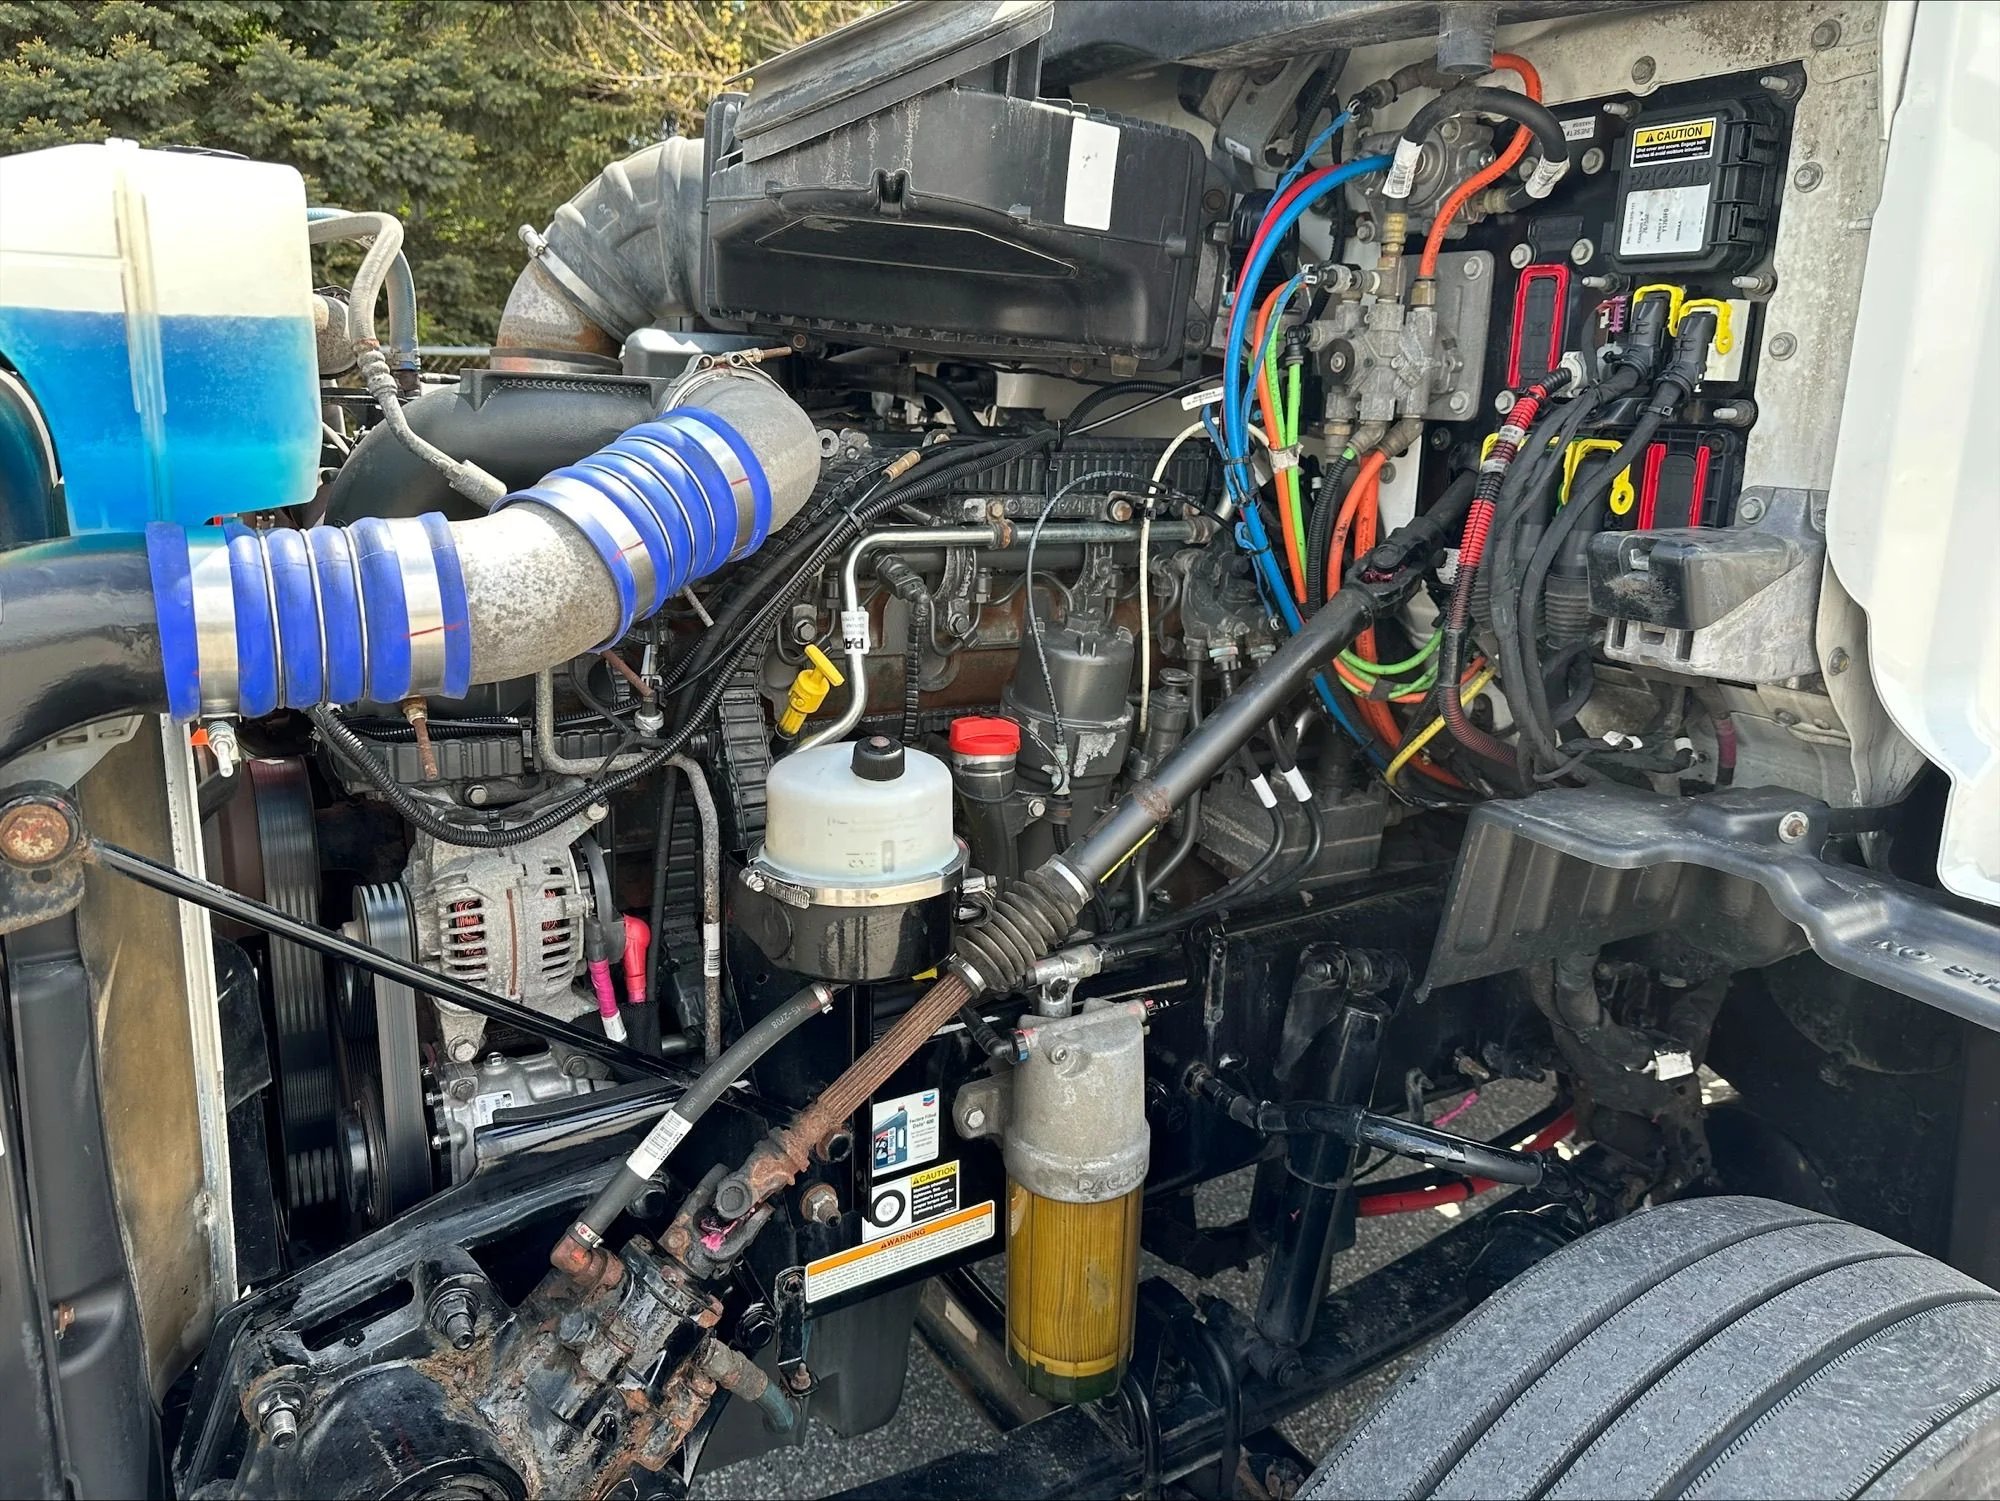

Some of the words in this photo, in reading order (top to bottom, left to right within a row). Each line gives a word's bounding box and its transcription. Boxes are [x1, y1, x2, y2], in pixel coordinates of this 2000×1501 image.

[1657, 126, 1703, 142] CAUTION
[1630, 161, 1711, 188] PACCAR
[919, 1166, 956, 1183] CAUTION
[886, 1228, 926, 1247] WARNING
